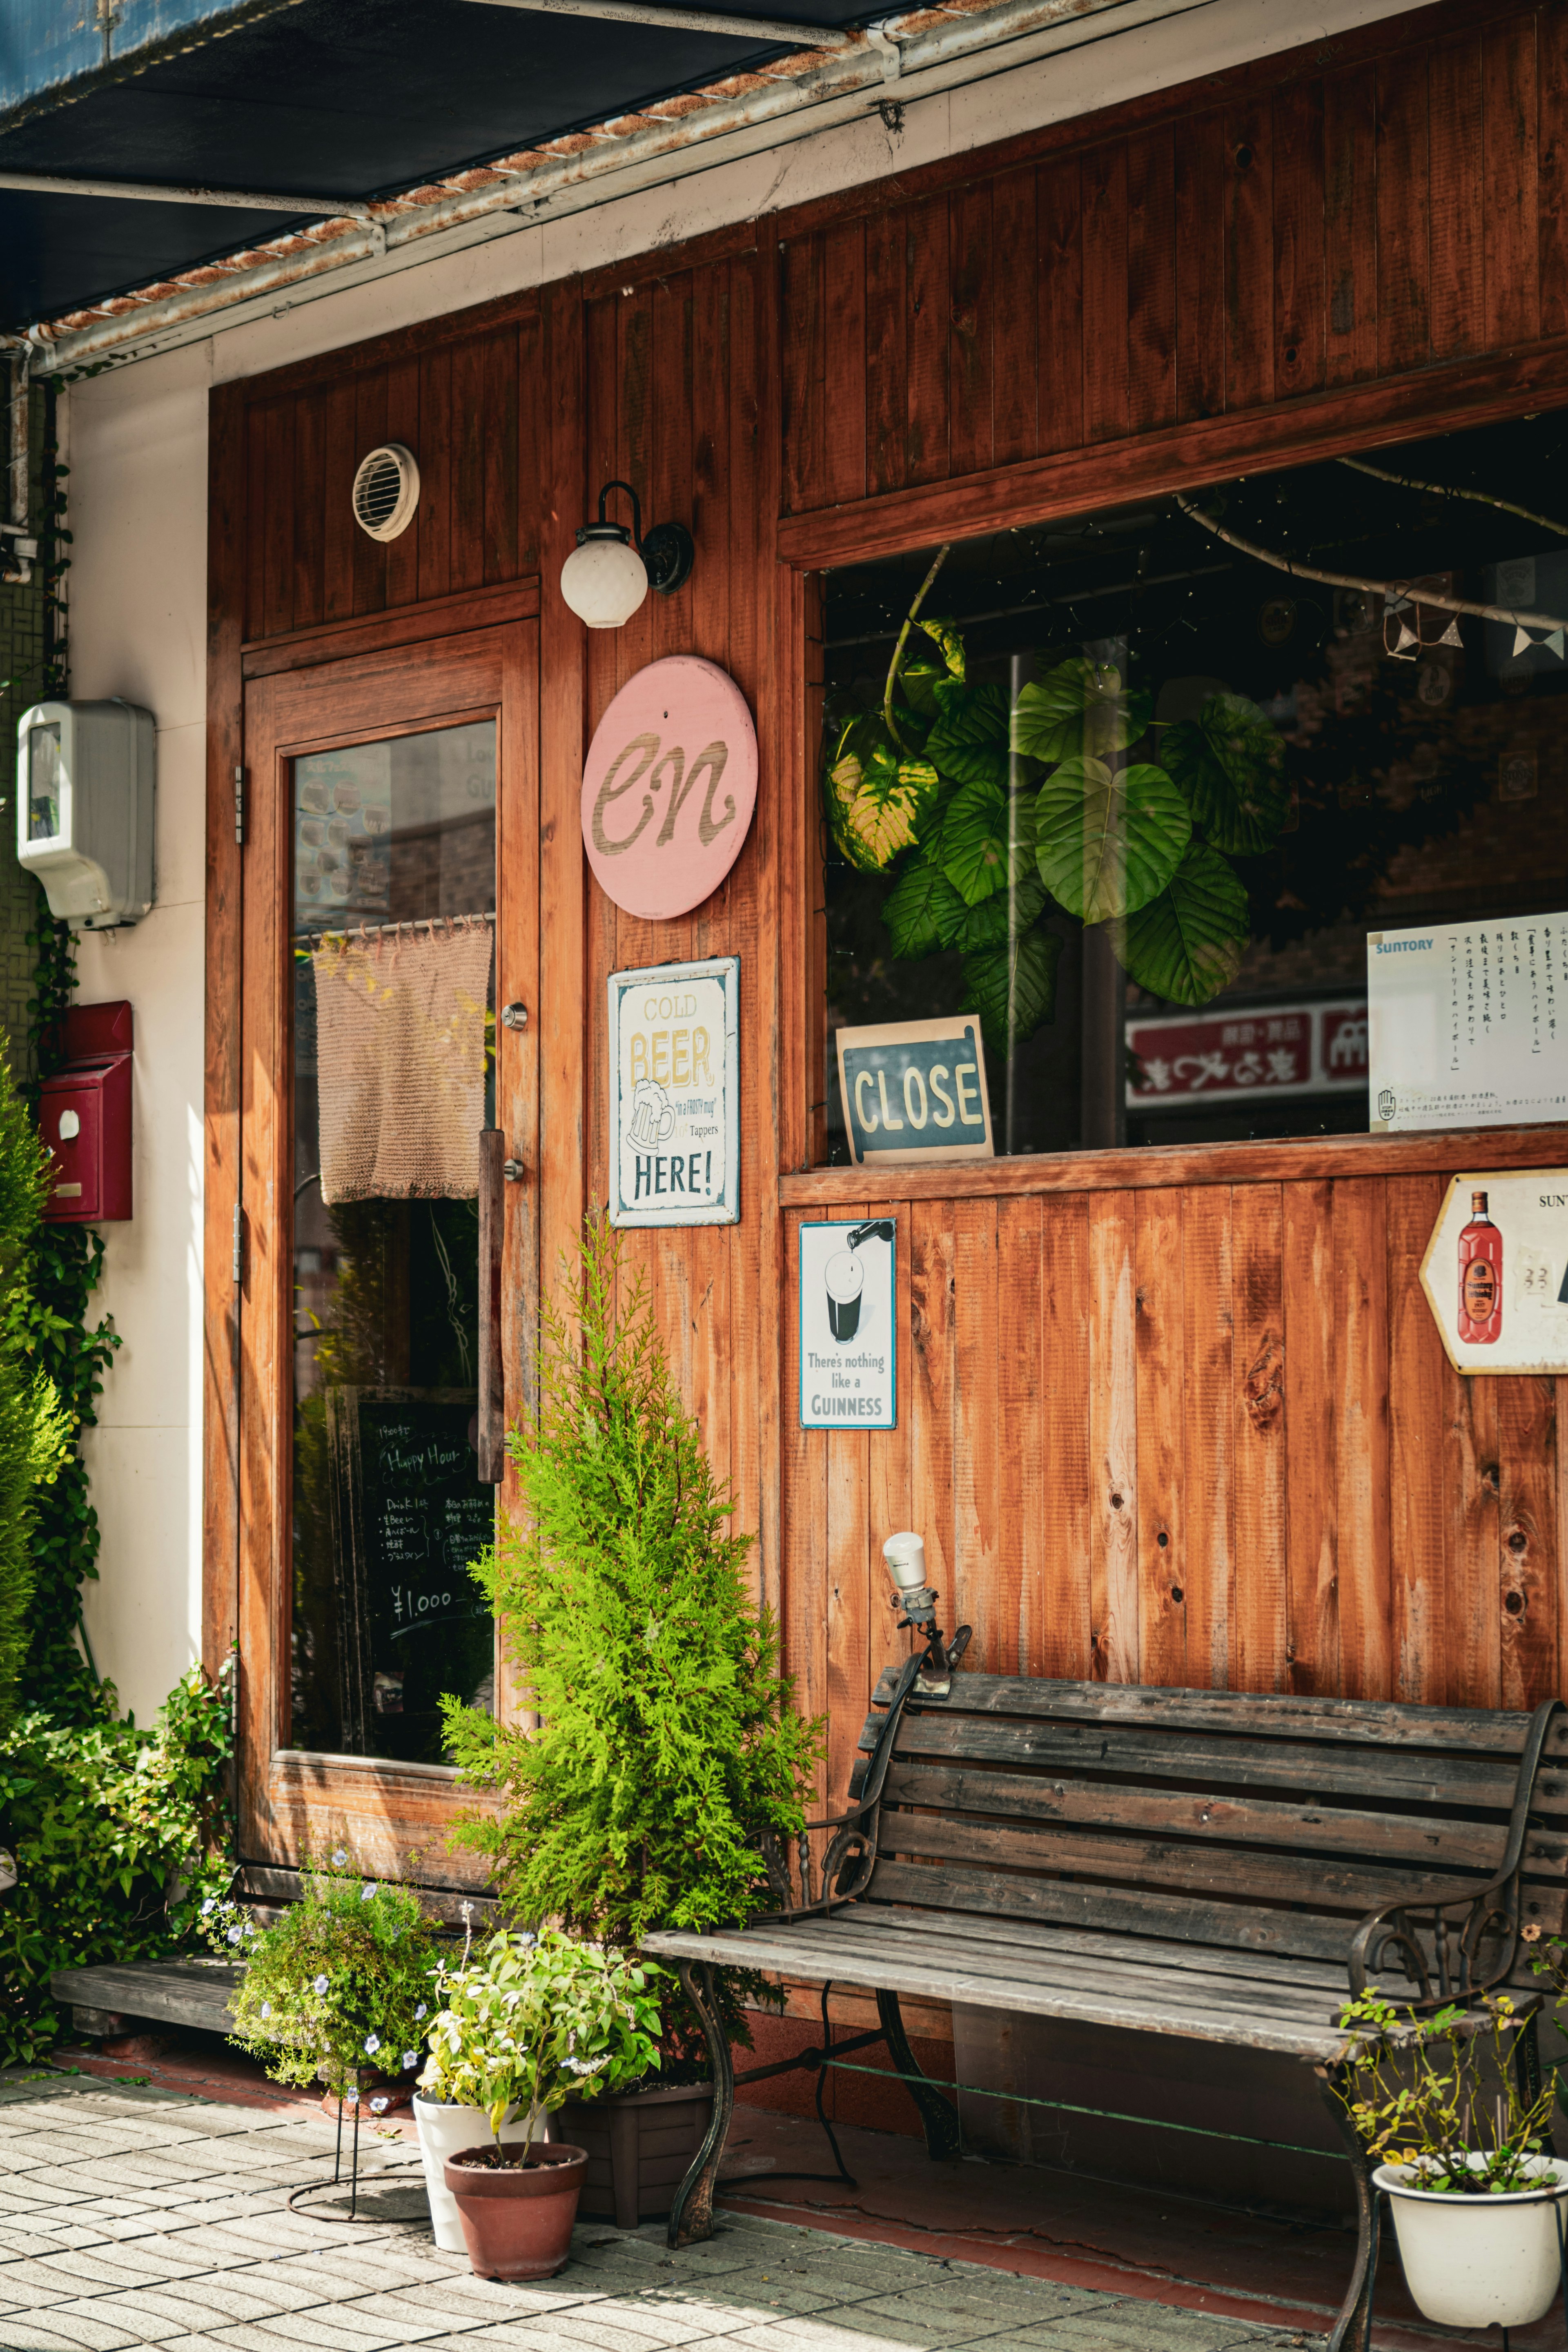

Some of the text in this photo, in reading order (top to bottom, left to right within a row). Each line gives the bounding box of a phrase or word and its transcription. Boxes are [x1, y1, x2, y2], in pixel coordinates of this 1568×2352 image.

[592, 733, 735, 855] en
[644, 994, 697, 1021] COLD
[630, 1026, 715, 1091] BEER
[683, 1103, 686, 1115] a
[687, 1099, 703, 1115] FROSTY
[855, 1063, 982, 1133] CLOSE
[690, 1125, 718, 1138] Tappers
[635, 1150, 711, 1200] HERE!
[1539, 1195, 1568, 1207] SUN
[808, 1352, 884, 1373] There's nothing
[832, 1373, 860, 1388] like a
[811, 1395, 882, 1416] GUINNESS
[388, 1443, 460, 1473] Happy Hour
